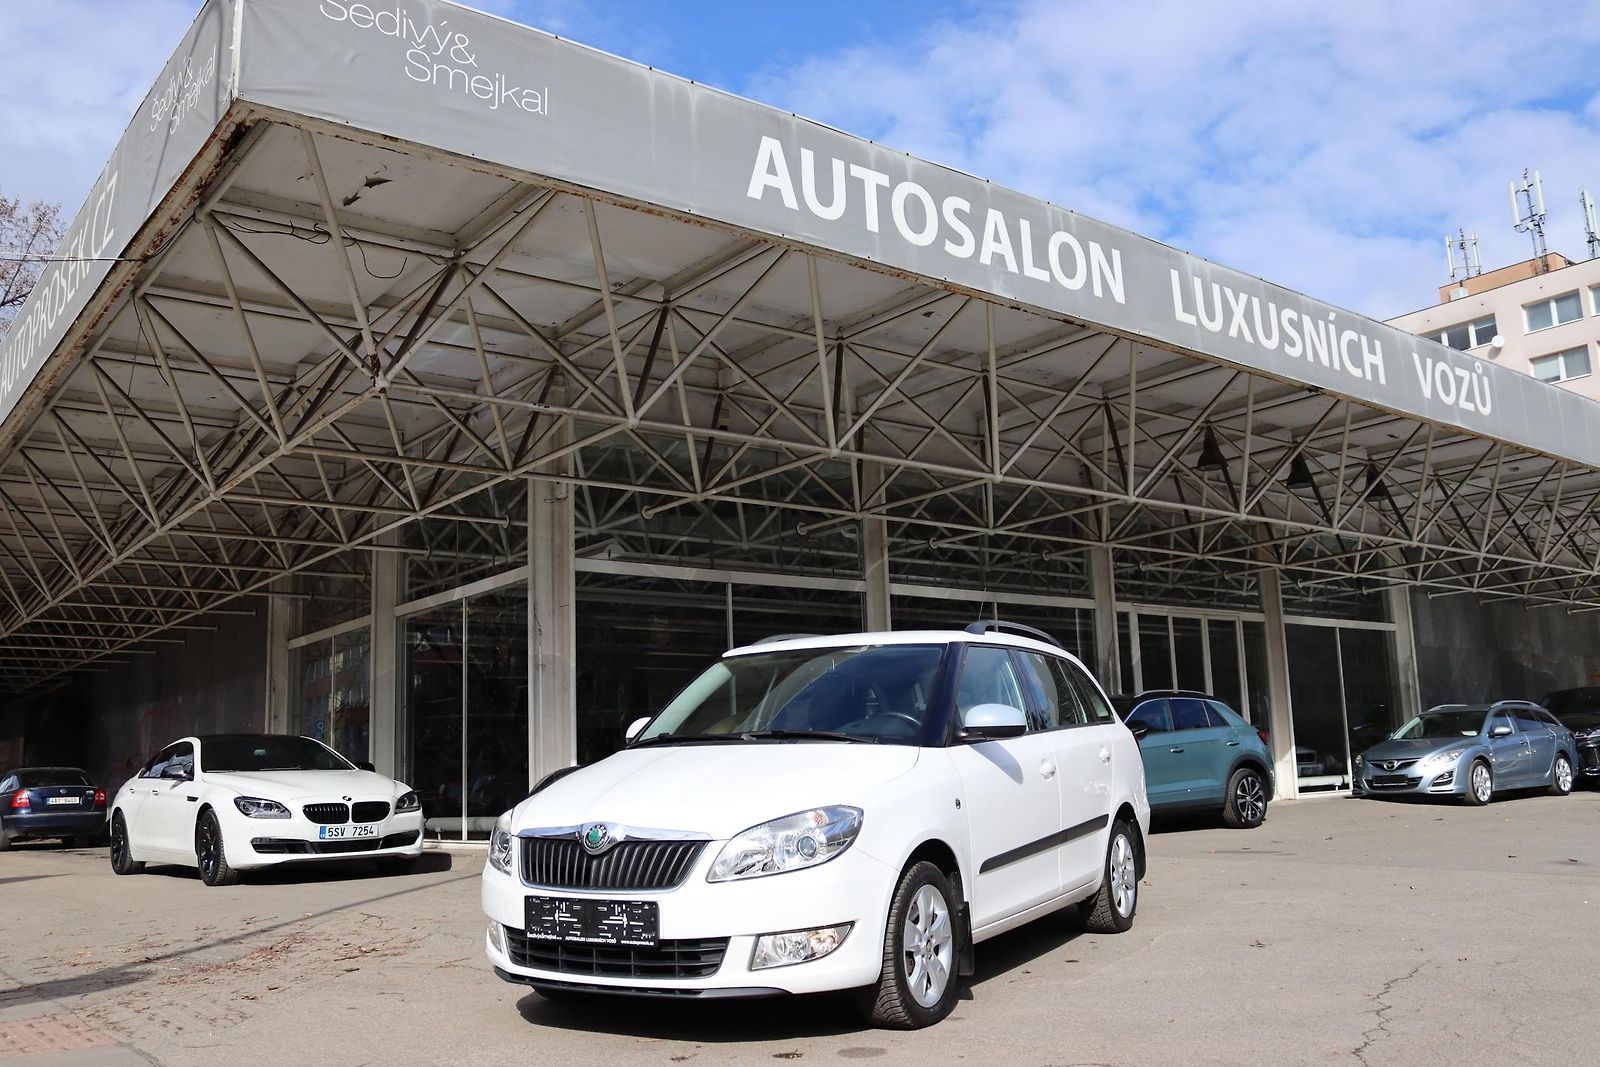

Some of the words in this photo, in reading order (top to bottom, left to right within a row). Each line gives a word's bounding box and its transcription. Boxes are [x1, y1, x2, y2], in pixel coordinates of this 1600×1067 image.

[405, 40, 548, 115] Šmejkal
[746, 135, 1126, 304] AUTOSALON
[1170, 268, 1387, 385] LUXUSNÍCH
[1412, 352, 1493, 416] VOZŮ
[328, 827, 346, 837] 5SV
[352, 826, 374, 836] 7254
